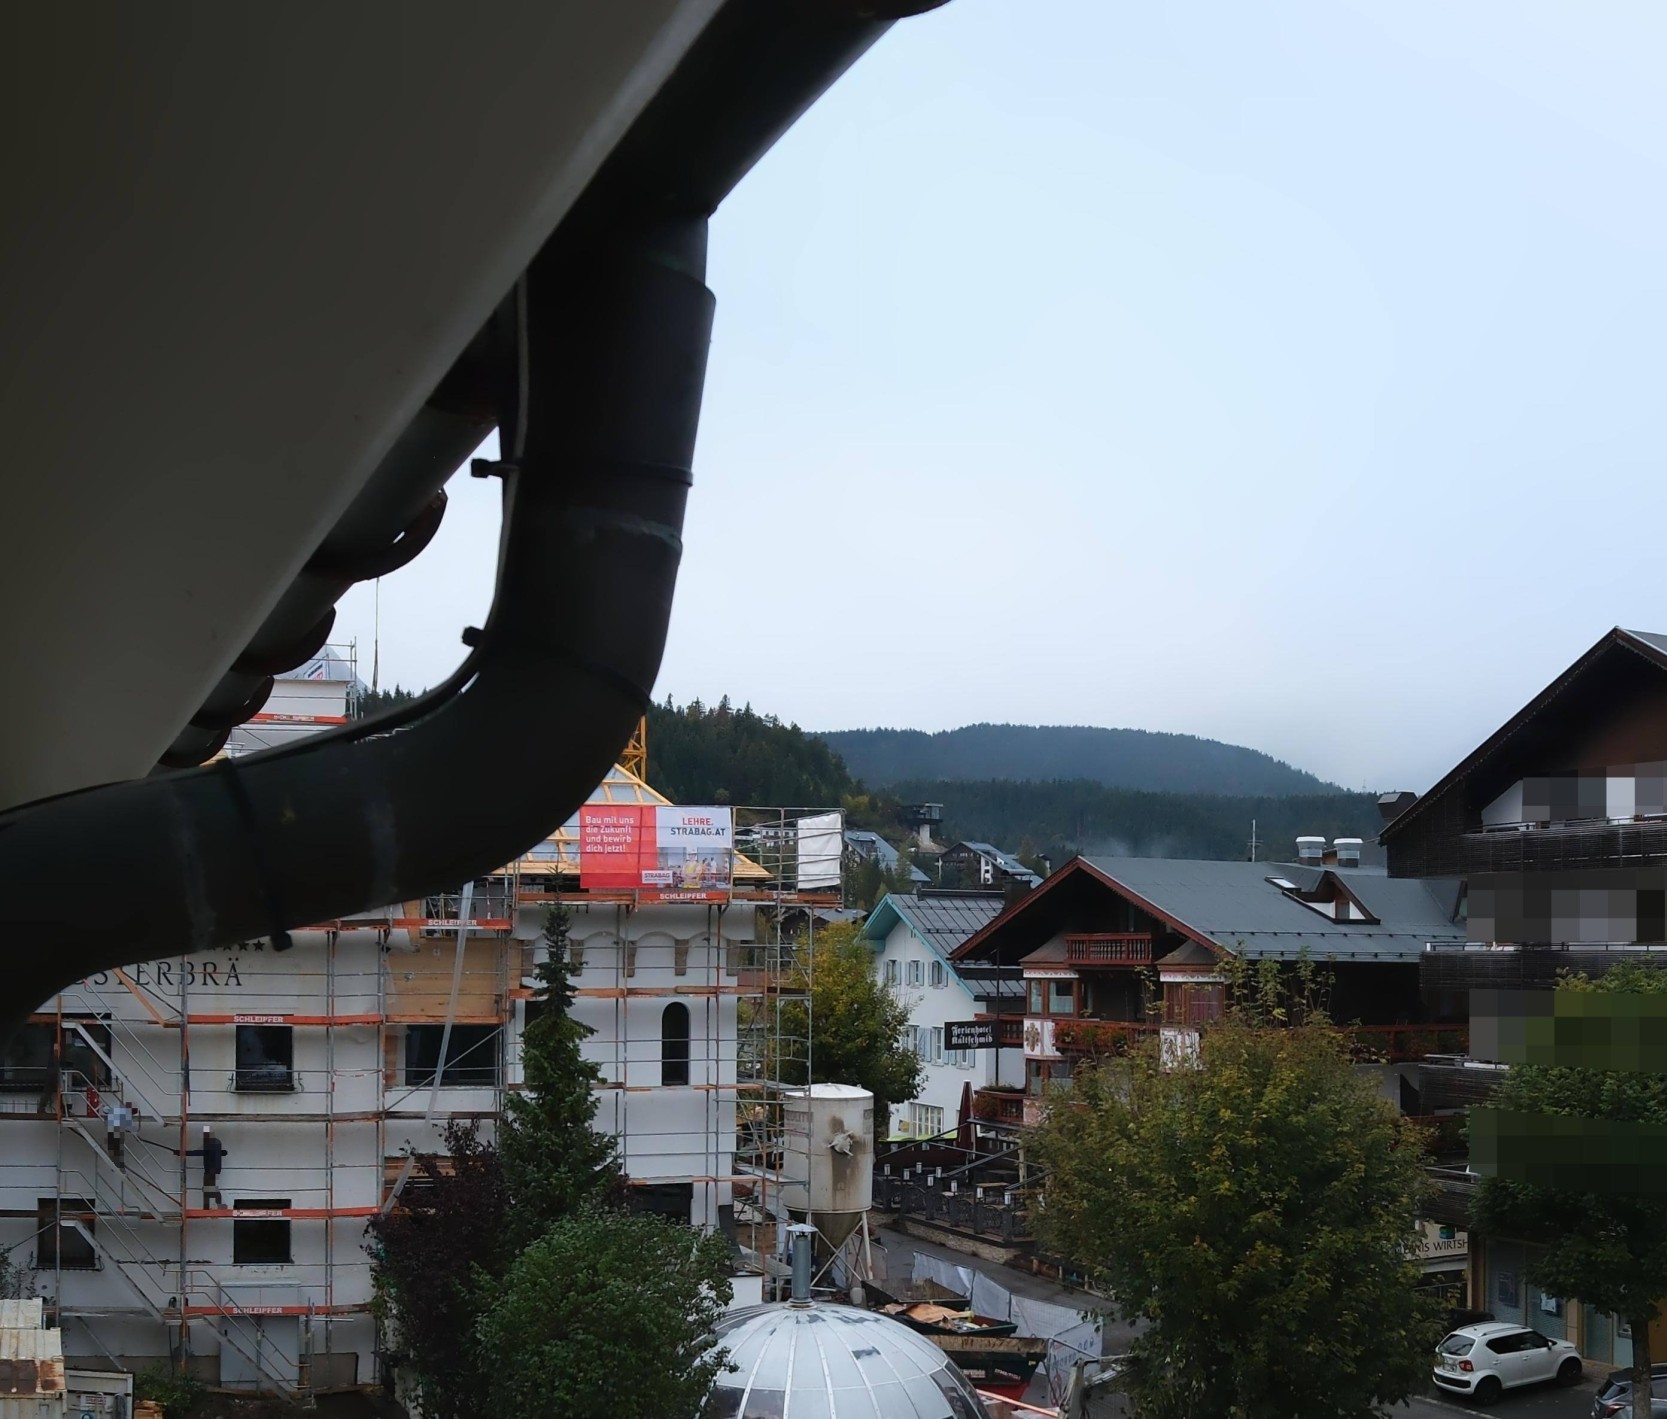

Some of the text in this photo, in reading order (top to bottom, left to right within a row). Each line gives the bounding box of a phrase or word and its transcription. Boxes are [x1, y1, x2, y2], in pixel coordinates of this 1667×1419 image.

[585, 816, 601, 824] Bau
[603, 815, 617, 824] mit
[682, 817, 714, 826] LEHRE.
[586, 826, 632, 834] die Zukunft
[670, 828, 726, 837] STRABAG.AT
[586, 835, 632, 843] und bewirb
[586, 844, 627, 854] dich jetzt!
[659, 892, 708, 900] SCHLEIPFER
[233, 1015, 284, 1023] SCHLEIPFER
[232, 1306, 283, 1314] SCHLEIPFER
